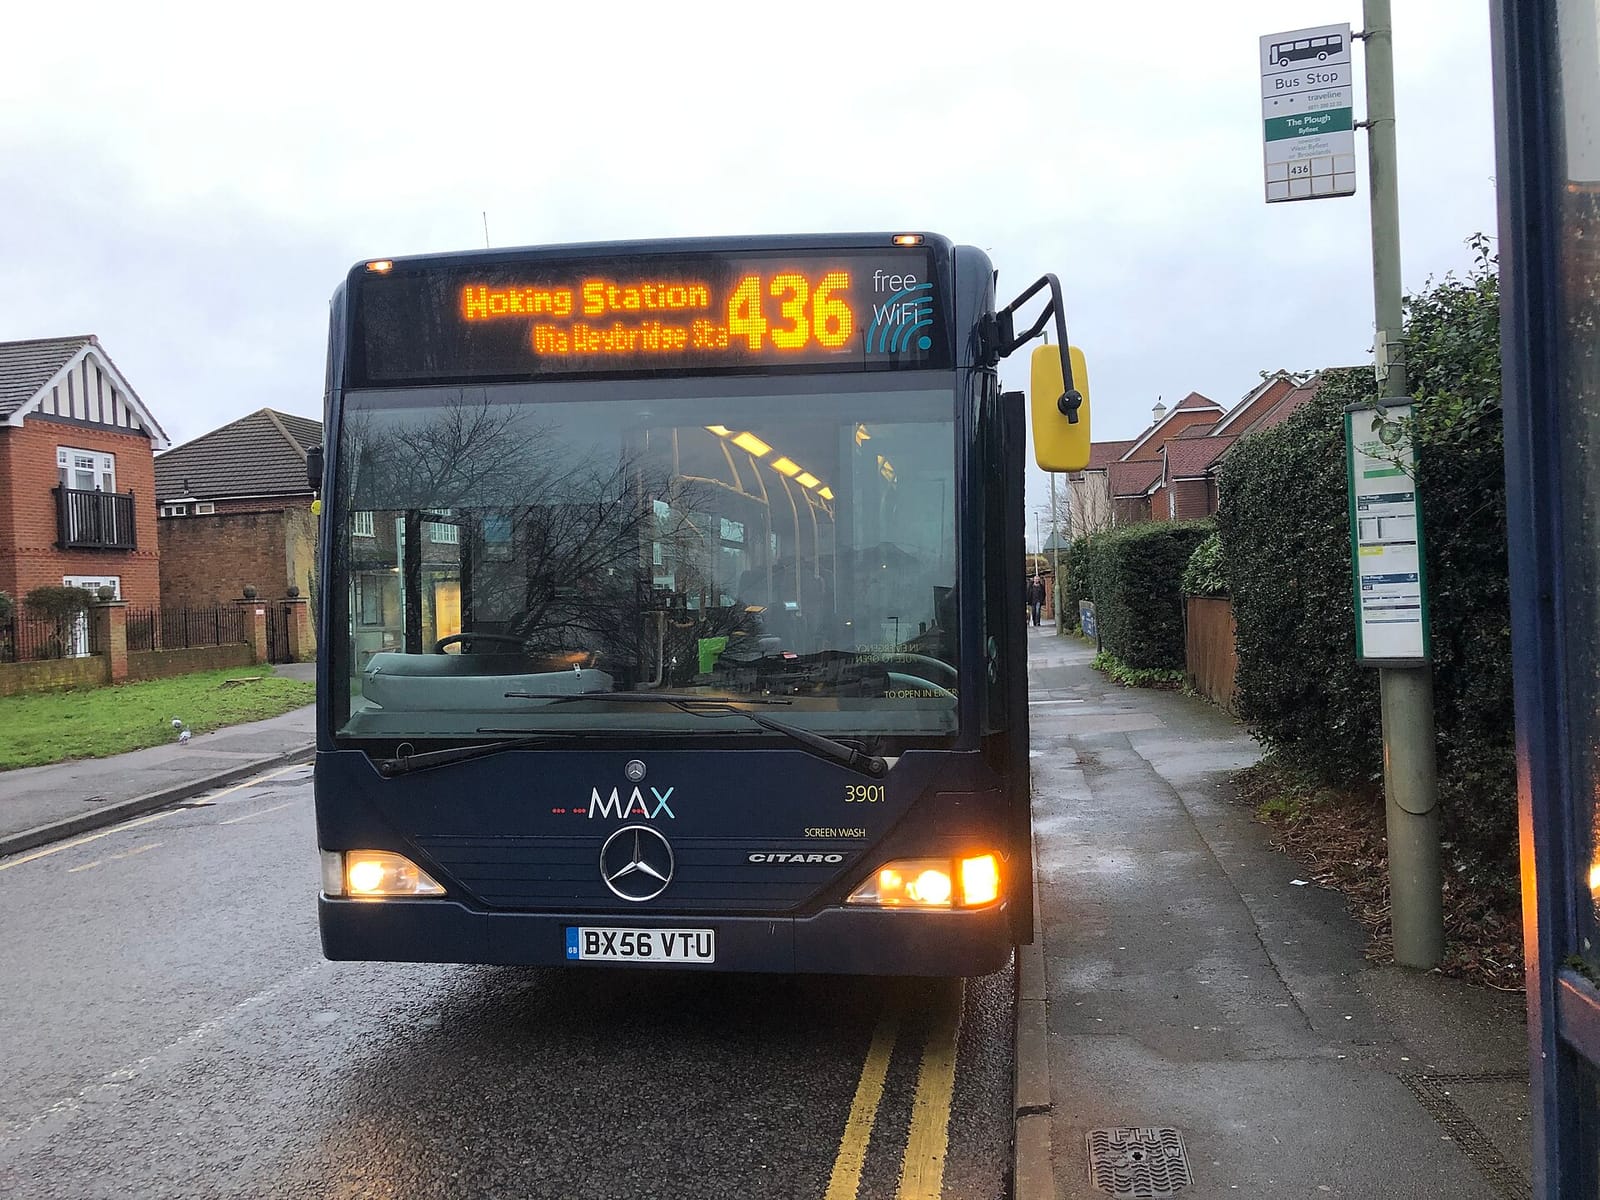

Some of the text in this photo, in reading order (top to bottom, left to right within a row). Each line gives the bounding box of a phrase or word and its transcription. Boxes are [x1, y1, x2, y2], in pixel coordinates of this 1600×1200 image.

[1275, 72, 1338, 90] Bus Stop
[1307, 91, 1342, 101] traveline
[1287, 113, 1331, 127] The Plough
[1298, 126, 1319, 135] Byfleet
[1291, 165, 1309, 175] 436
[873, 269, 917, 293] free
[466, 282, 708, 318] Woking Station
[728, 272, 852, 350] 436
[873, 303, 918, 326] WiFi
[535, 325, 568, 352] Via
[693, 319, 728, 348] Sta
[884, 690, 896, 699] TO
[897, 689, 921, 699] OPEN
[922, 689, 932, 698] IN
[588, 786, 675, 819] MAX
[844, 785, 886, 803] 3901
[804, 827, 866, 838] SCREEN WASH
[748, 854, 843, 863] CITARO
[584, 931, 711, 958] BX56 VTU
